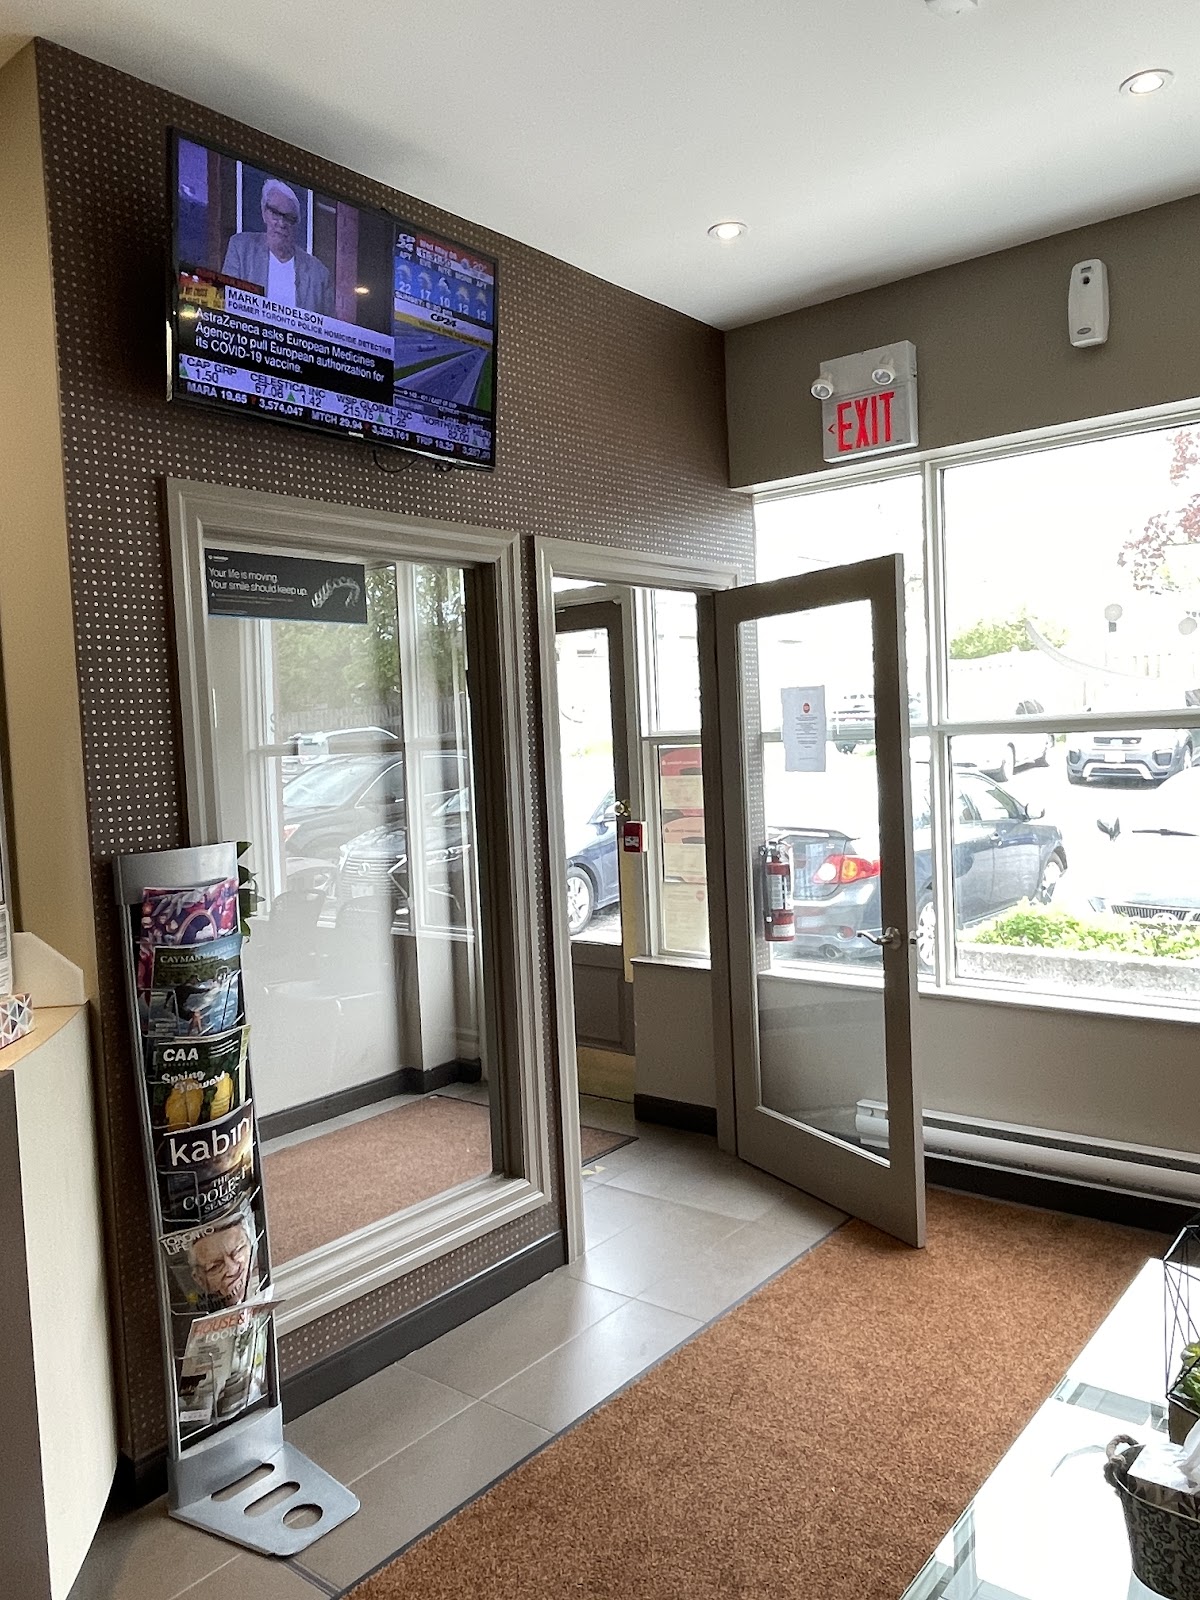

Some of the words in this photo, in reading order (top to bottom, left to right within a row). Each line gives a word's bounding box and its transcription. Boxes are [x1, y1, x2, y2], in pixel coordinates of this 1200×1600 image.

[228, 289, 260, 307] MARK
[262, 300, 324, 325] MENDELSON
[399, 281, 411, 294] 22
[420, 289, 431, 301] 17
[440, 296, 451, 308] 10
[228, 300, 260, 316] FORMER
[261, 311, 296, 327] TORONTO
[298, 321, 322, 334] POLICE
[324, 329, 357, 345] HOMICIDE
[358, 339, 392, 355] DETECTIVE
[430, 313, 457, 328] CP24
[195, 321, 235, 344] Agency
[237, 333, 248, 345] to
[249, 338, 268, 351] pull
[270, 341, 315, 363] European
[316, 356, 372, 380] authorization
[372, 370, 385, 382] for
[196, 307, 260, 335] AstraZeneca
[261, 329, 284, 342] asks
[286, 333, 330, 355] European
[332, 346, 376, 367] Medicines
[195, 335, 209, 349] its
[211, 340, 262, 363] COVID-19
[264, 355, 303, 374] vaccine.
[186, 357, 211, 369] CAP
[214, 364, 237, 376] GRP
[250, 373, 306, 395] CELESTICA
[308, 387, 326, 398] INC
[335, 394, 358, 405] WSP
[359, 400, 396, 416] GLOBAL
[397, 410, 413, 420] INC
[422, 415, 471, 434] NORTHWEST
[186, 382, 218, 397] MARA
[220, 390, 248, 404] 19.65
[311, 410, 338, 425] MTCH
[195, 368, 219, 383] 1.50
[255, 382, 284, 398] 67.08
[301, 394, 322, 408] 1.42
[343, 404, 374, 420] 215.75
[389, 415, 407, 428] 1.25
[836, 391, 895, 452] EXIT
[208, 566, 227, 578] Your
[227, 568, 240, 579] life
[240, 570, 248, 580] is
[208, 578, 228, 590] Your
[228, 580, 250, 591] smile
[250, 582, 277, 594] should
[277, 585, 297, 595] keep
[160, 952, 202, 964] CAYMAN
[163, 1047, 199, 1062] CAA
[161, 1070, 206, 1085] Spring
[169, 1117, 250, 1167] kabin
[161, 1226, 215, 1247] TORONTO
[192, 1317, 236, 1335] HOUSE
[205, 1328, 236, 1343] LOOK
